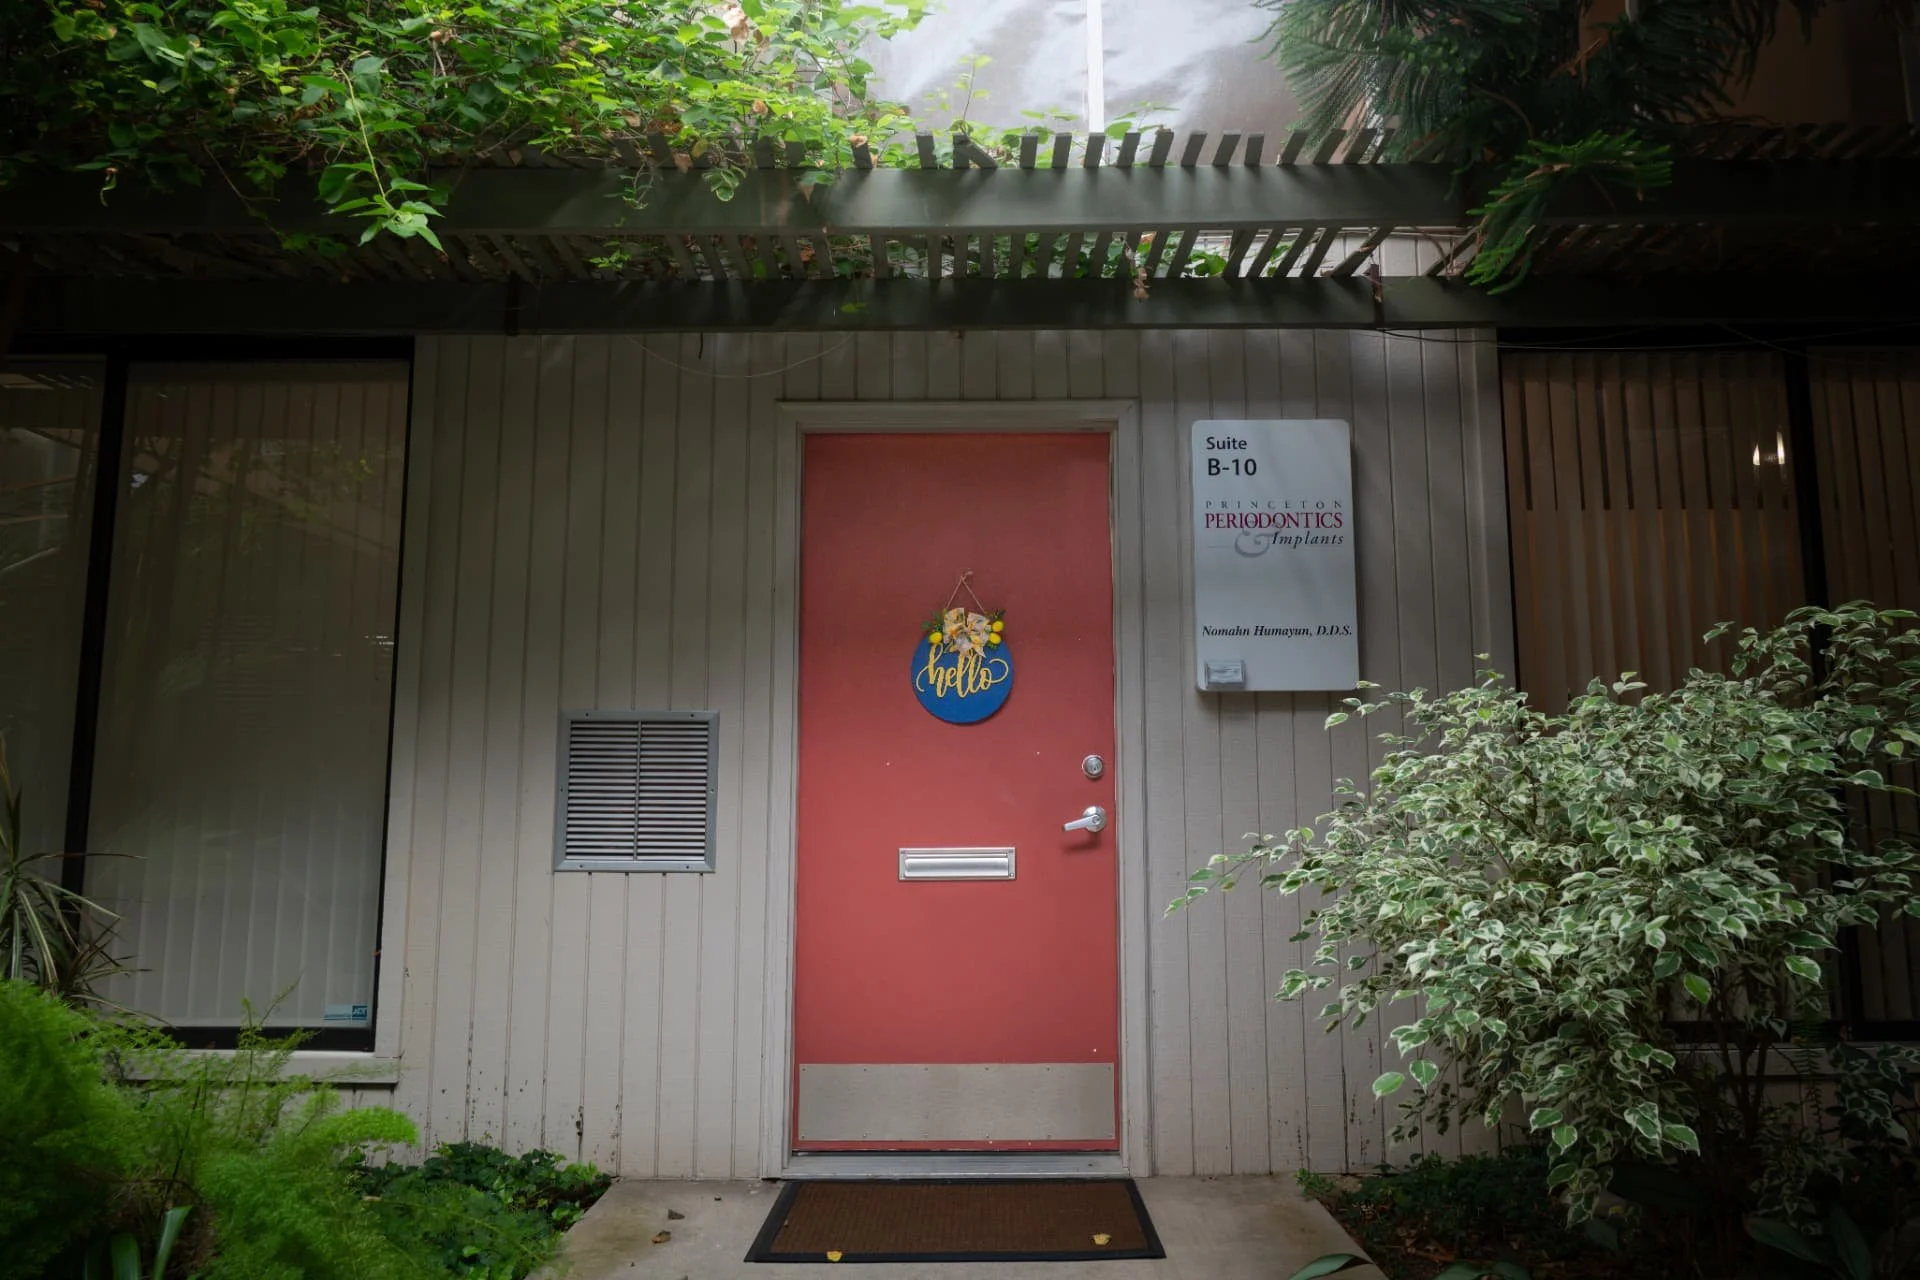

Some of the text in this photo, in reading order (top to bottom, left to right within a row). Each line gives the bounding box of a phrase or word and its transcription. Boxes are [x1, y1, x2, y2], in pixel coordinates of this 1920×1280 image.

[1206, 436, 1247, 450] Suite
[1208, 458, 1257, 476] B-10
[1205, 500, 1343, 509] PRINCETON
[1205, 512, 1343, 529] PERIODONTICS
[1272, 530, 1344, 549] Implants
[1202, 625, 1353, 638] Nomahn Humayun, D.D.S.
[916, 643, 1009, 698] hello
